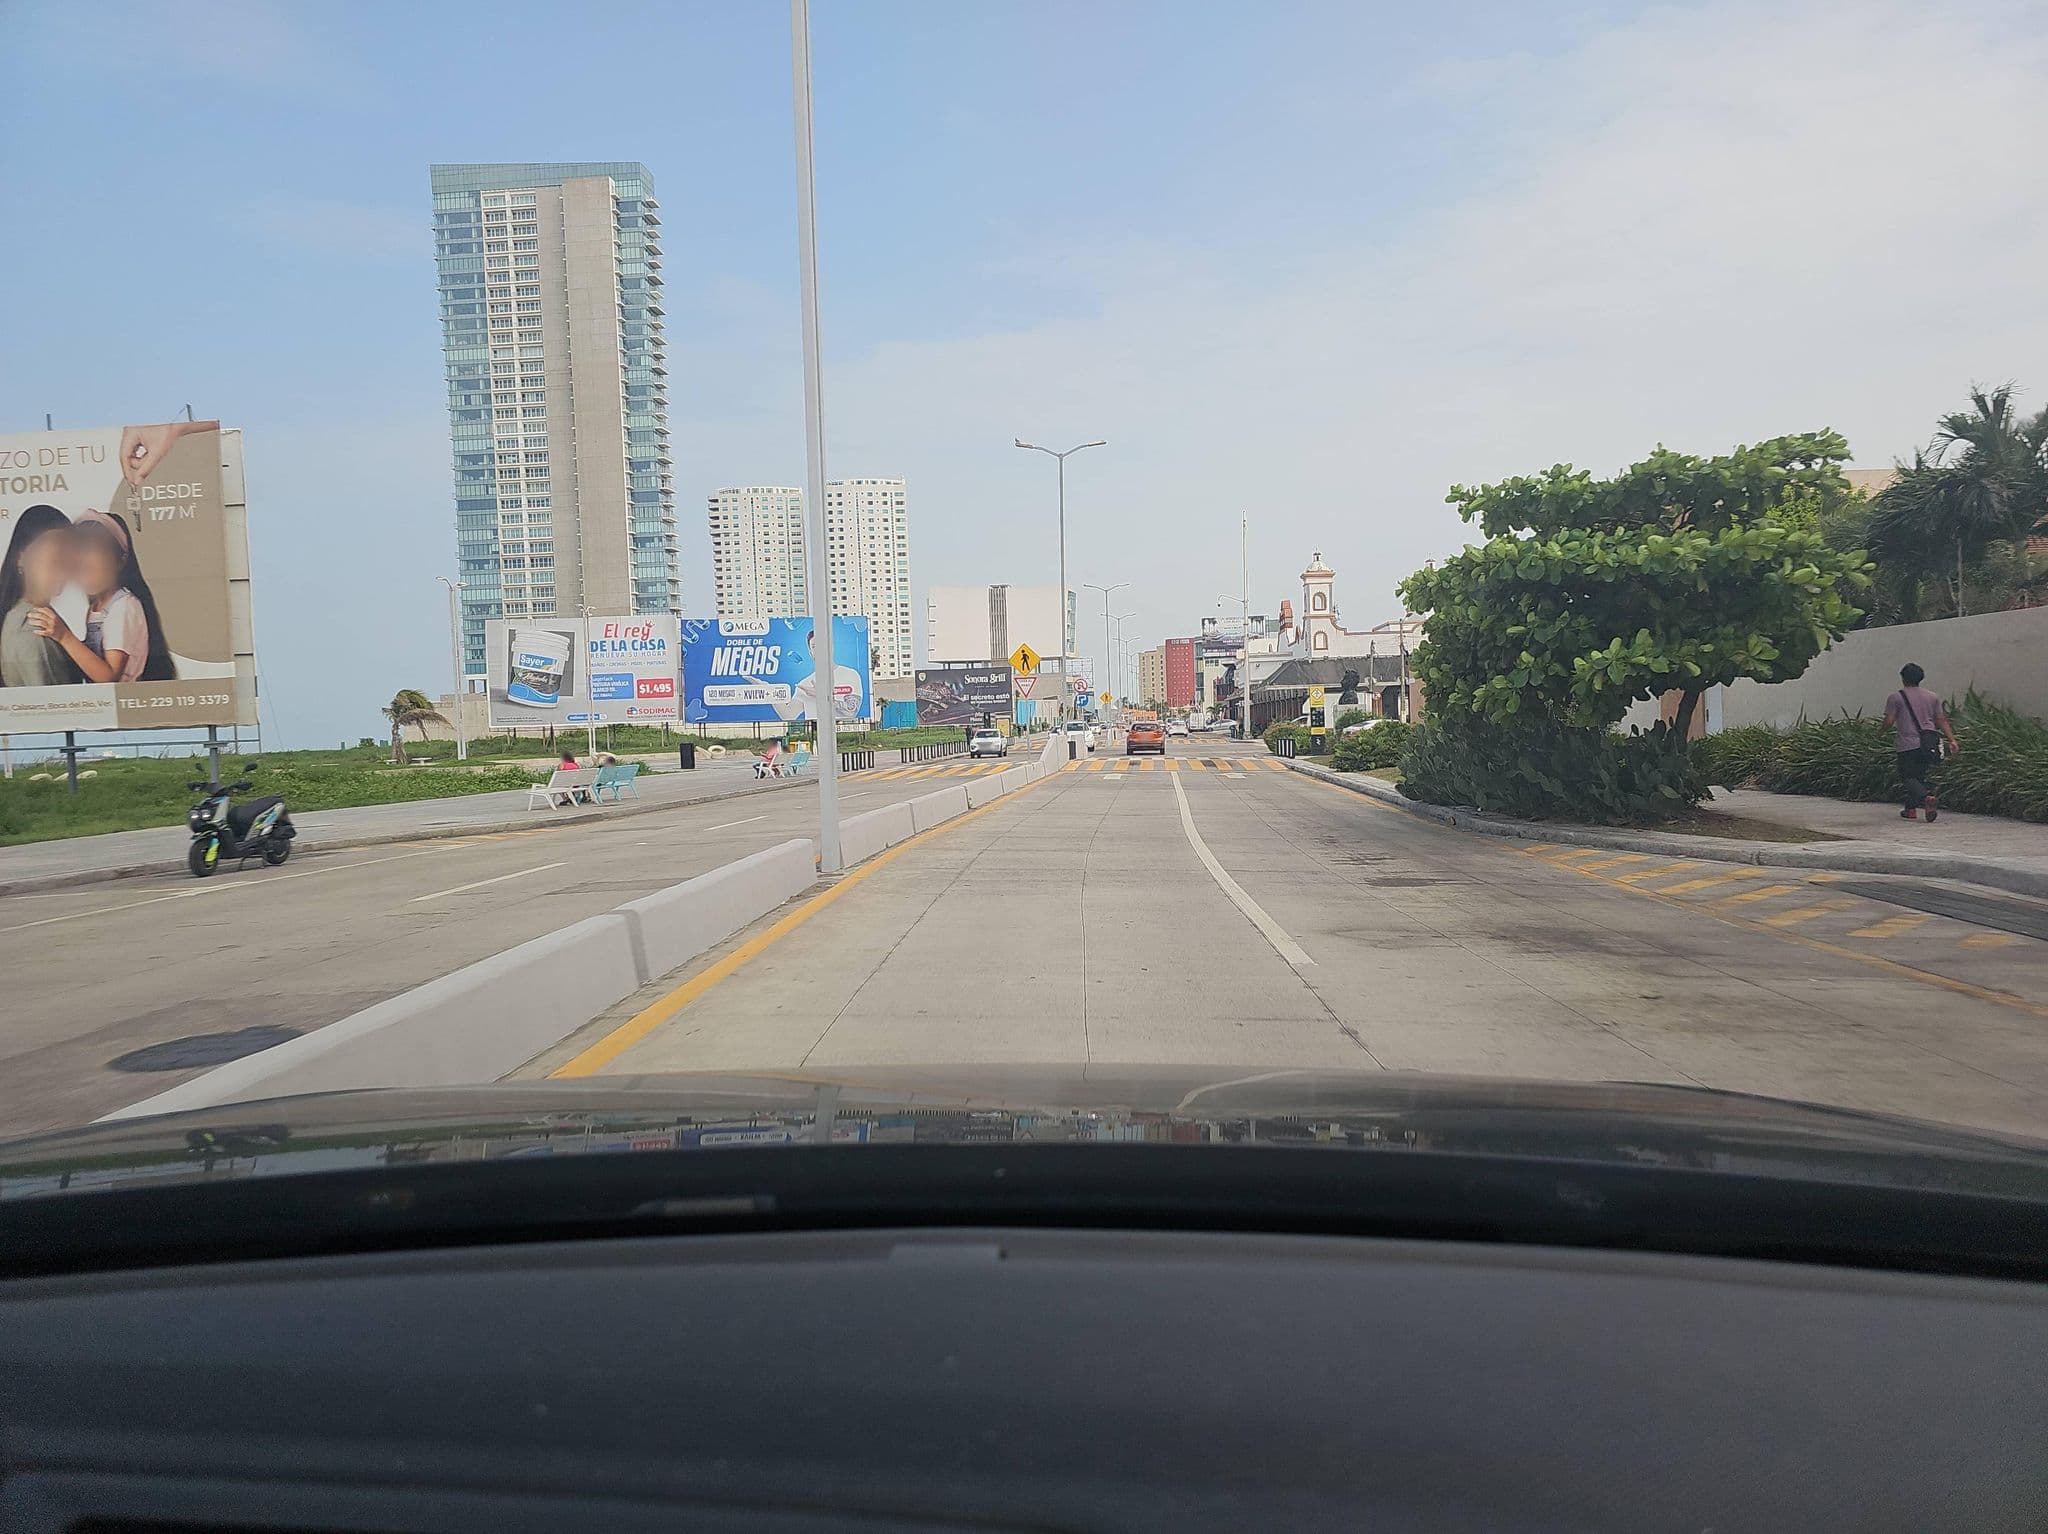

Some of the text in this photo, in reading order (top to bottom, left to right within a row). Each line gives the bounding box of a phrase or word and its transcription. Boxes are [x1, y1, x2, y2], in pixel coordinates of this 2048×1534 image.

[39, 447, 70, 466] DE
[76, 445, 105, 464] TU
[141, 483, 203, 501] DESDE
[149, 506, 176, 521] 177
[604, 623, 651, 641] El rey
[735, 622, 764, 631] MEGA
[590, 638, 666, 653] DE LA CASA
[753, 638, 764, 646] DE
[520, 654, 544, 667] Sayer
[711, 645, 781, 676] MEGAS
[964, 674, 988, 684] Sonora
[639, 683, 672, 694] $1,495
[120, 695, 230, 709] TEL: 229 119 3379
[639, 707, 676, 715] SODIMAC
